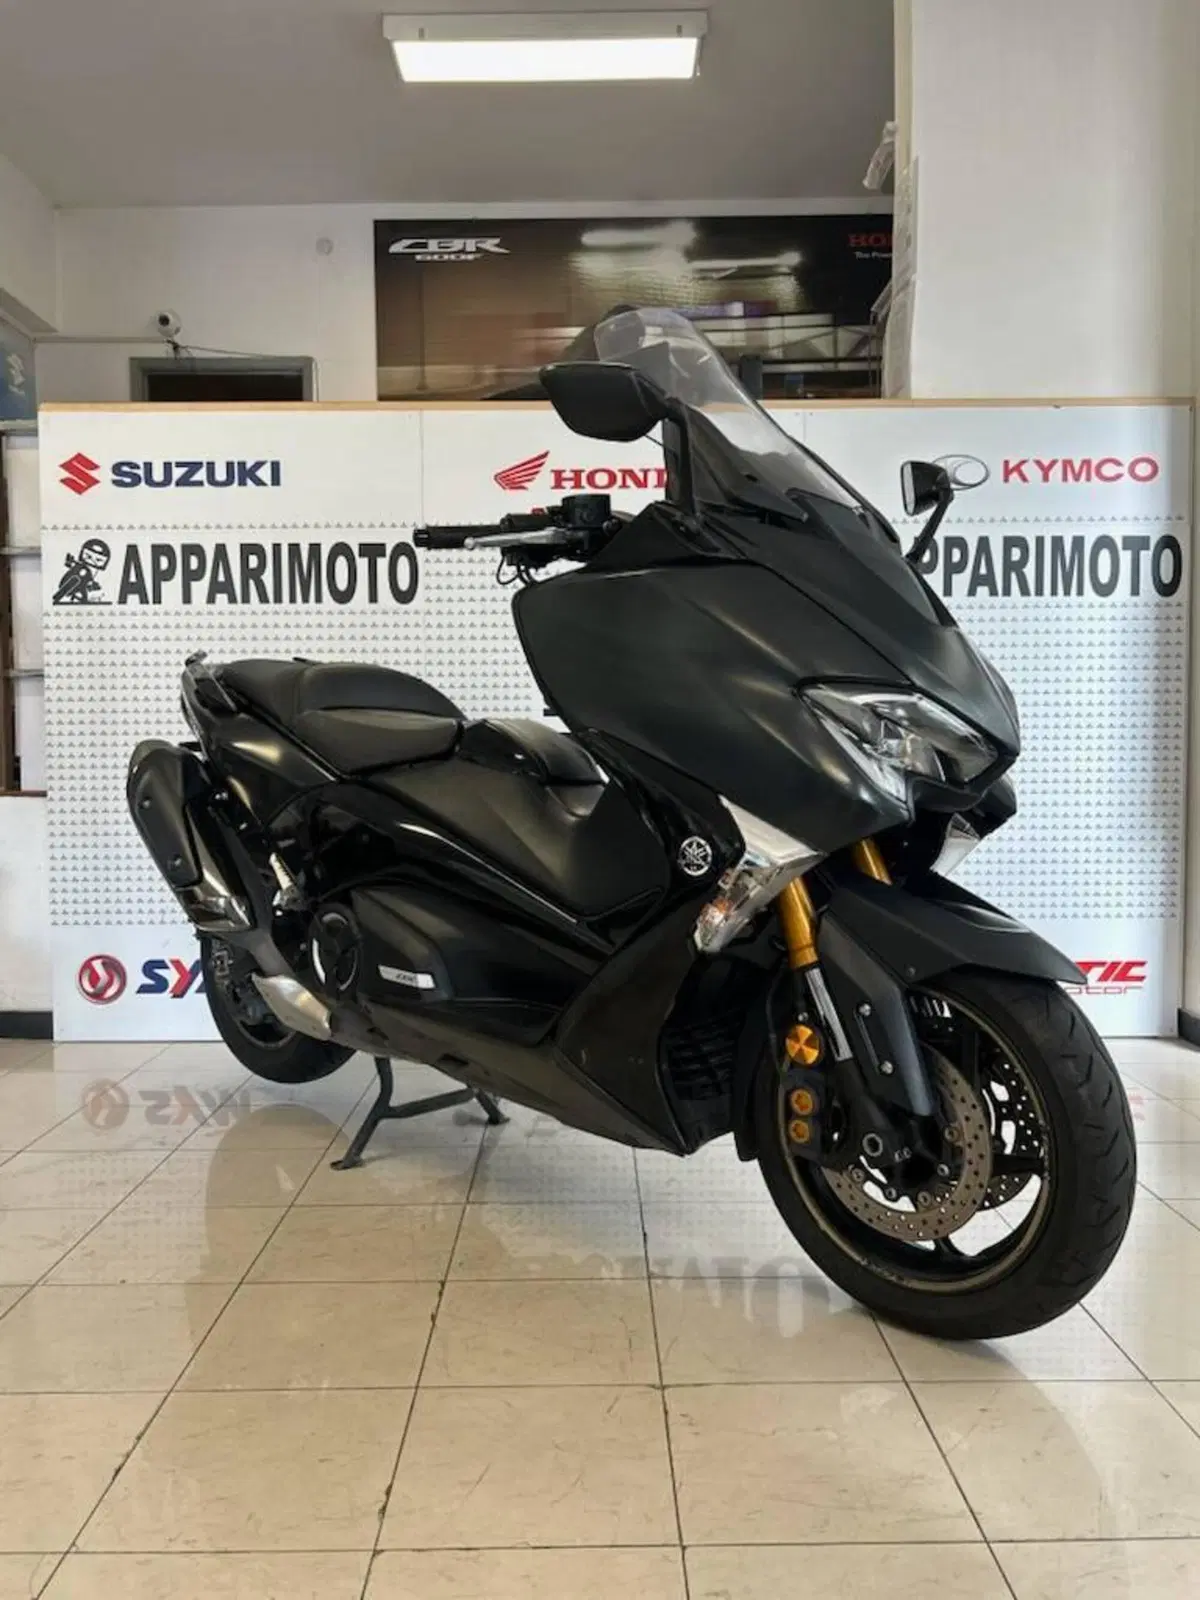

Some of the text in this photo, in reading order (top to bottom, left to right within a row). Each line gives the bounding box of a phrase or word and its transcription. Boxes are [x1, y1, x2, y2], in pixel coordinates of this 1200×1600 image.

[388, 238, 511, 254] CBR
[111, 460, 281, 488] SUZUKI
[1002, 457, 1159, 483] KYMCO
[117, 541, 419, 605] APPARIMOTO
